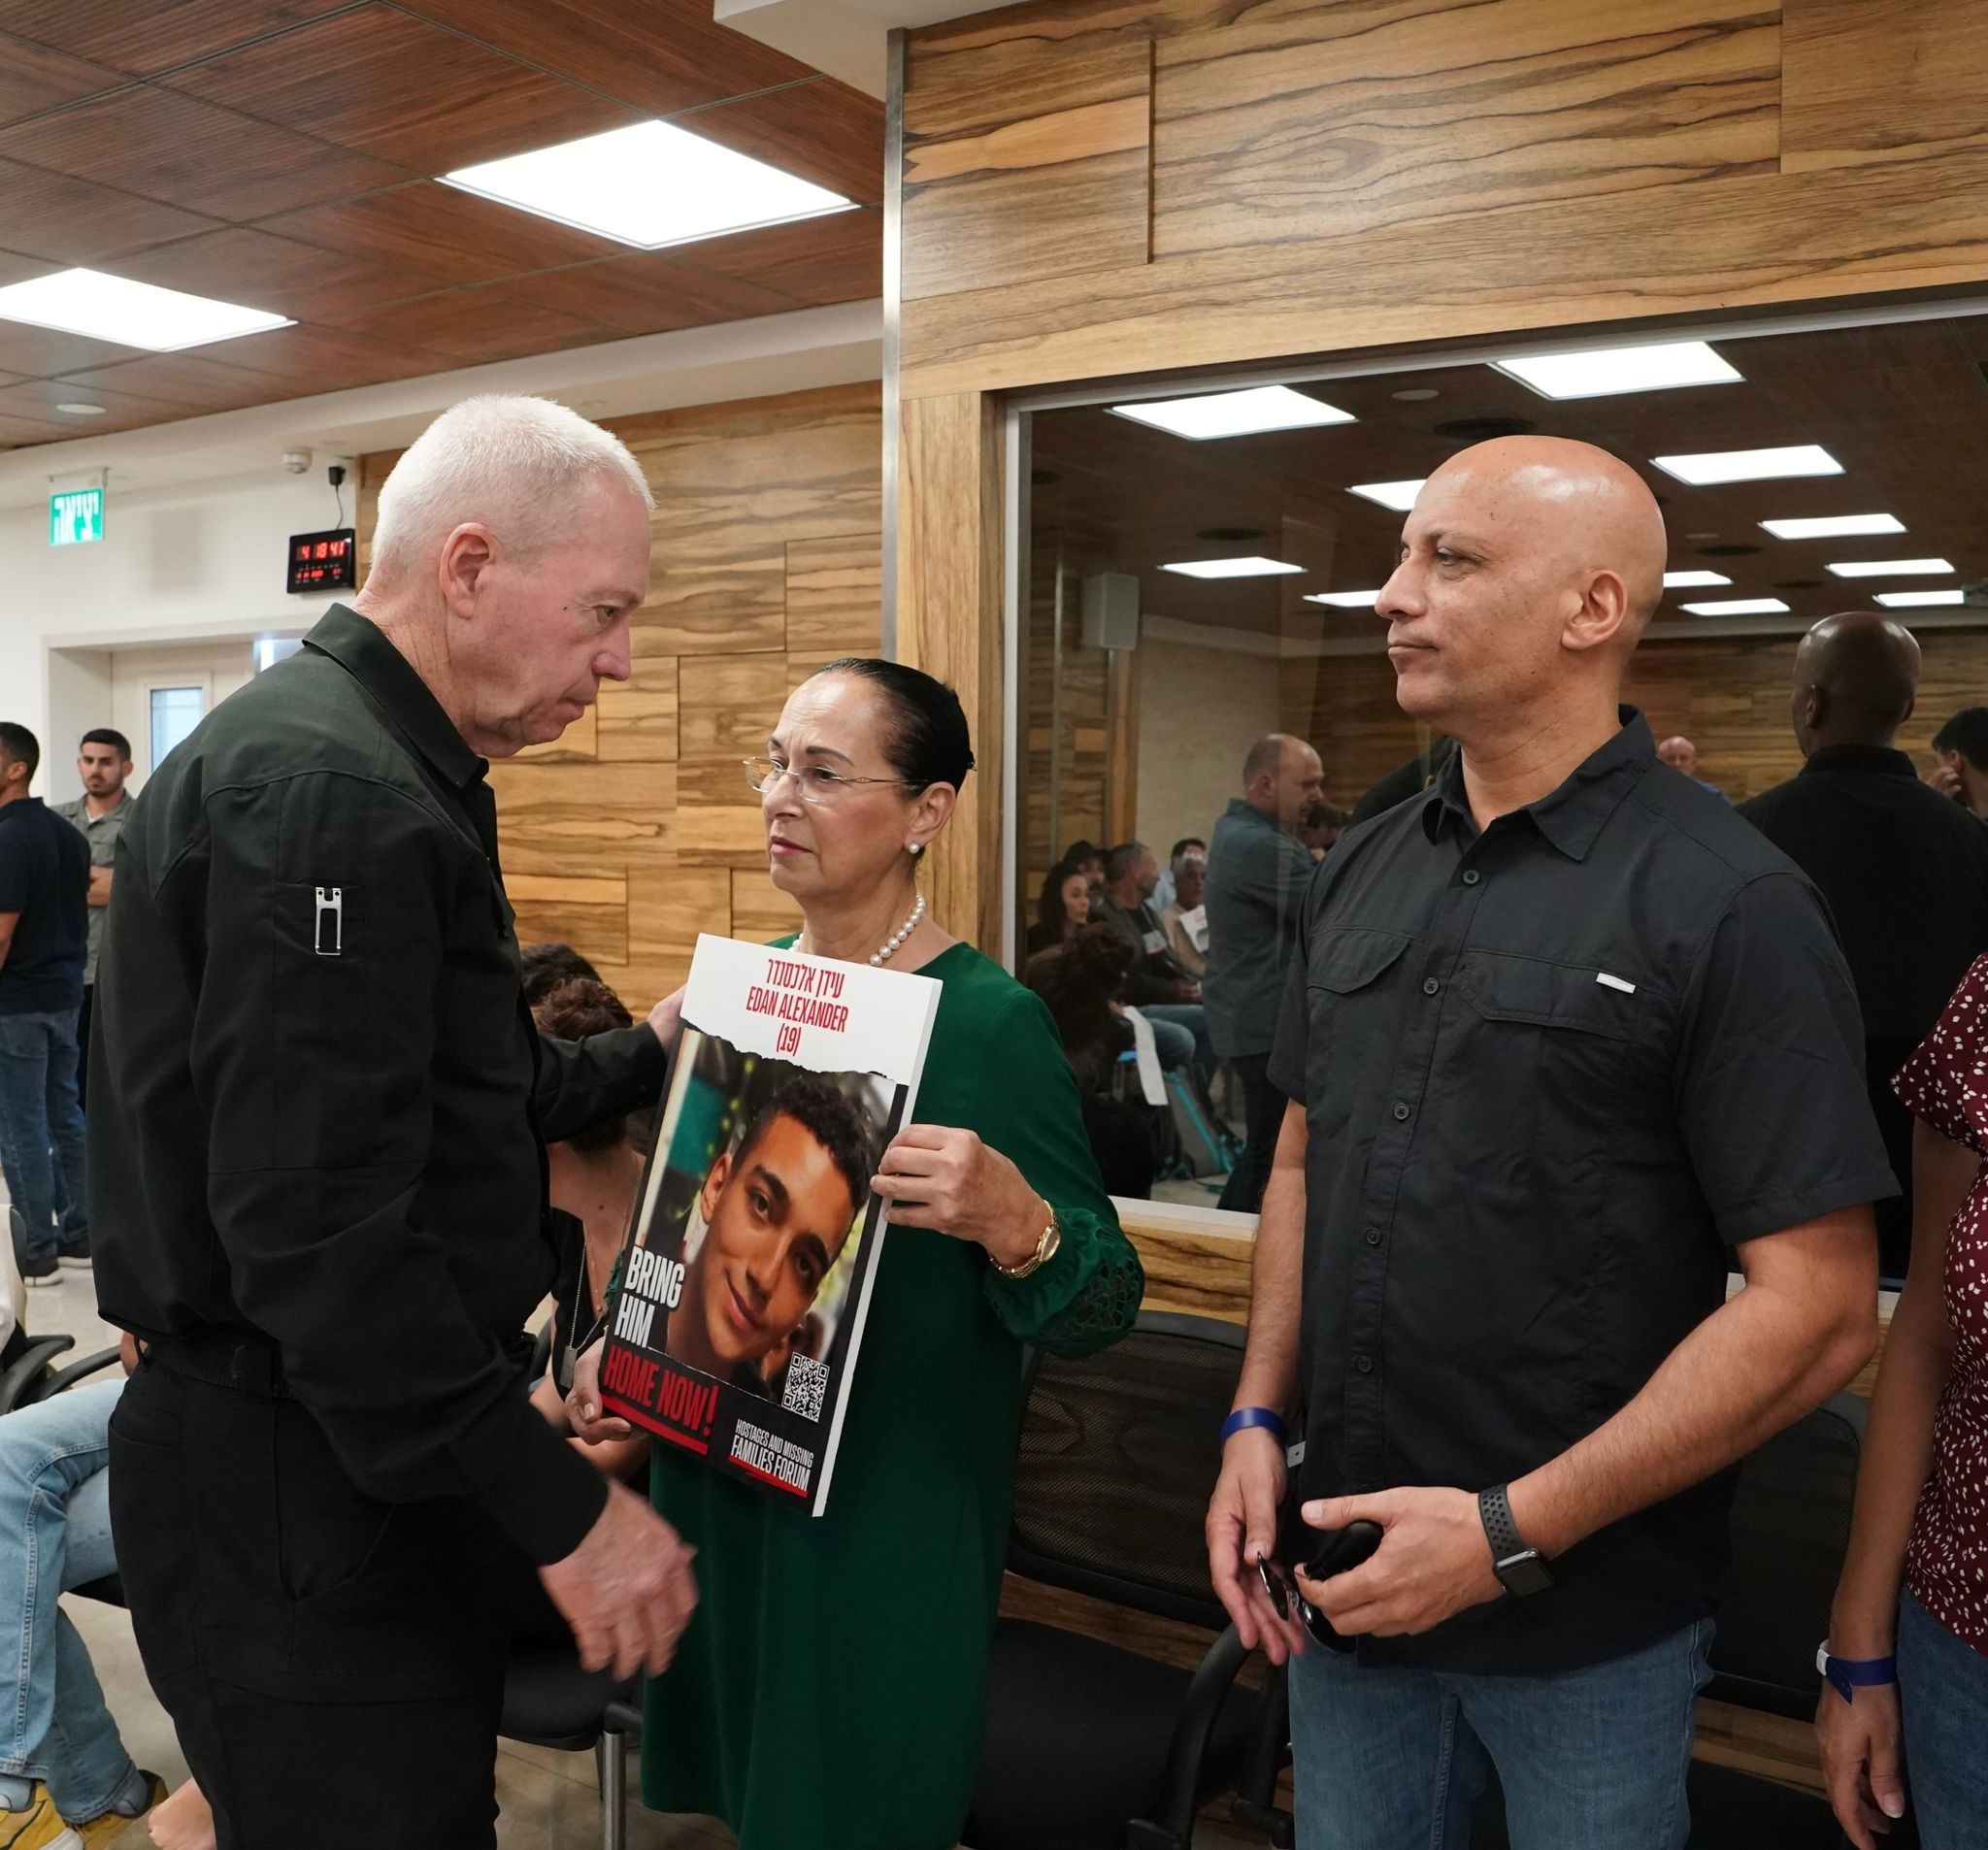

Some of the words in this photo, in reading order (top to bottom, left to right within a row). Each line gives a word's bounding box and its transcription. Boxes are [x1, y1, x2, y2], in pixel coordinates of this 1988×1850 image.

[766, 958, 817, 993] אלכסנדר
[815, 969, 845, 999] עידן
[746, 985, 779, 1017] EDAN
[777, 993, 849, 1033] ALEXANDER
[776, 1022, 802, 1057] (19)
[624, 1245, 685, 1308] BRING
[613, 1293, 655, 1349] HIM
[603, 1345, 660, 1407] HOME
[655, 1367, 720, 1437] NOW!
[730, 1434, 775, 1474] FAMILIES
[773, 1454, 812, 1492] FORUM
[735, 1418, 770, 1447] HOSTAGES
[767, 1434, 784, 1454] AND
[781, 1439, 814, 1469] MISSING
